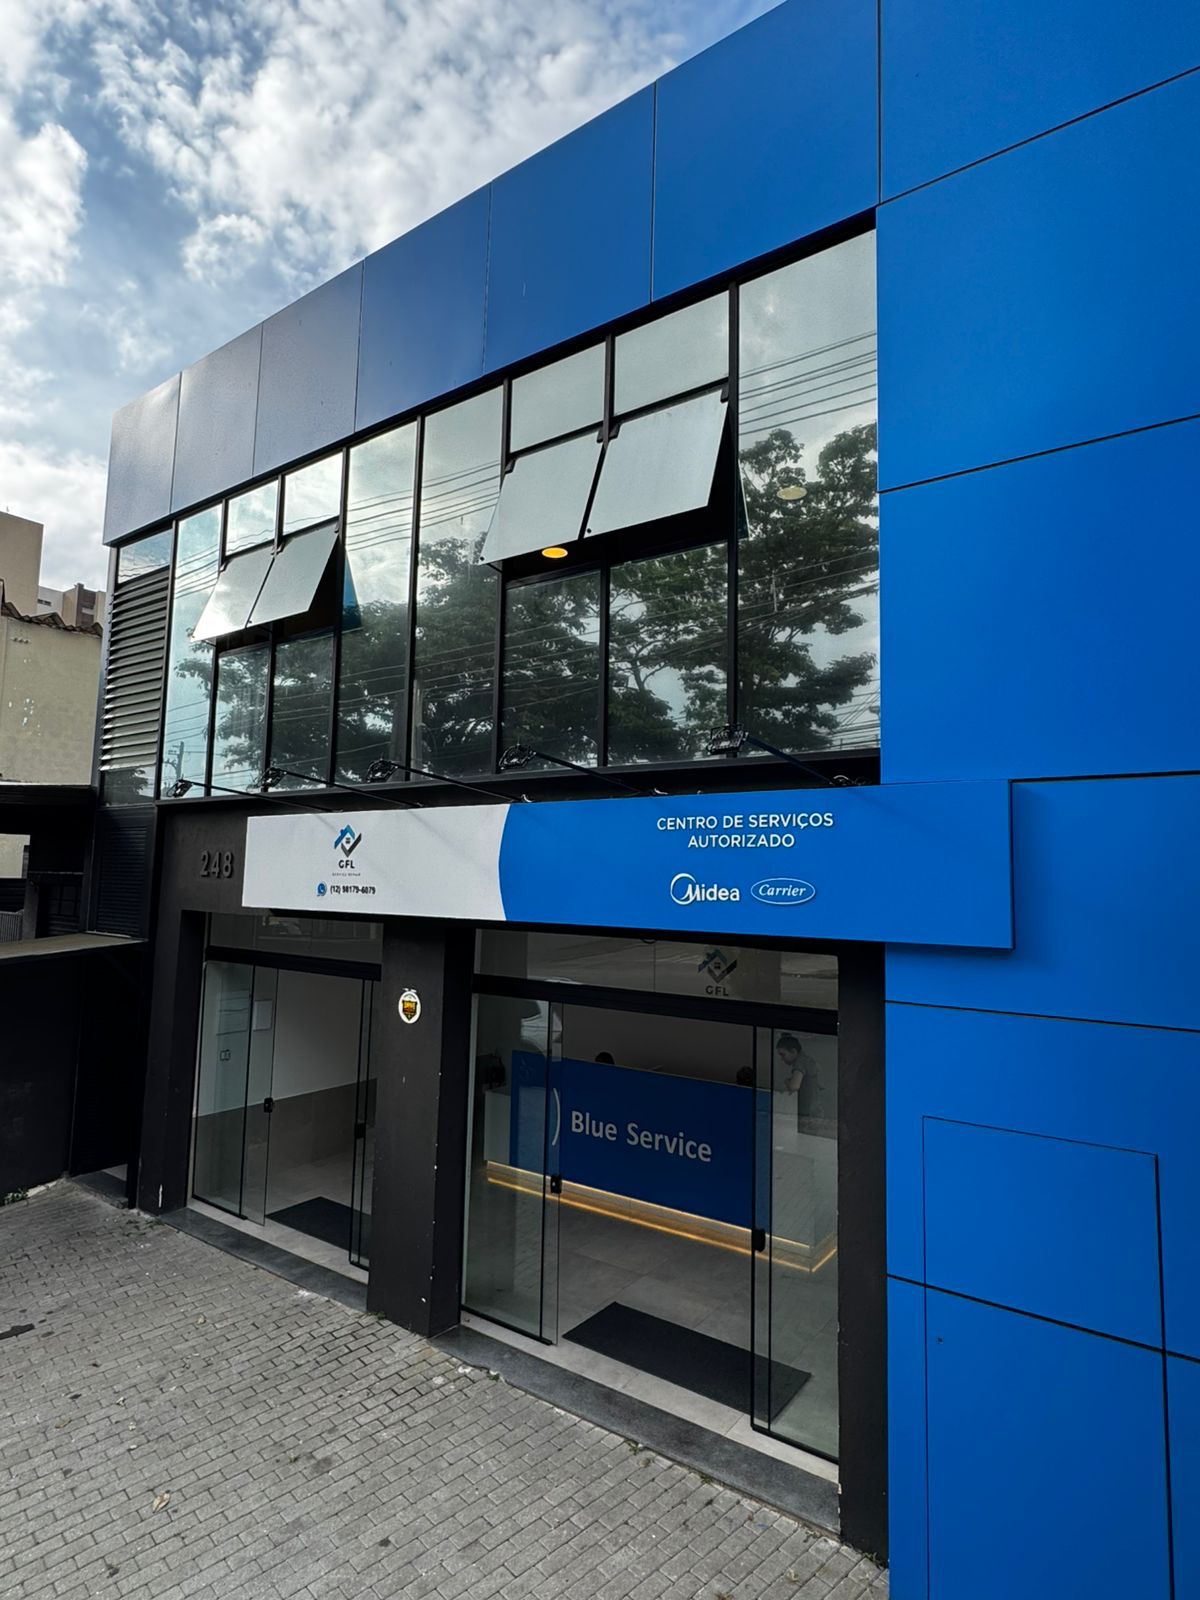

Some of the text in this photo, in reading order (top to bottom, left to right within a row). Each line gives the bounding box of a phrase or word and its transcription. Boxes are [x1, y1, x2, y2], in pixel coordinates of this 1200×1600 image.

[656, 812, 834, 831] CENTRO DE SERVIÇOS
[687, 833, 795, 848] AUTORIZADO
[199, 850, 233, 878] 248
[338, 860, 355, 869] GFL
[670, 872, 740, 905] Midea
[758, 883, 807, 897] Carrier
[705, 985, 729, 997] GFL
[571, 1110, 712, 1162] Blue Service
